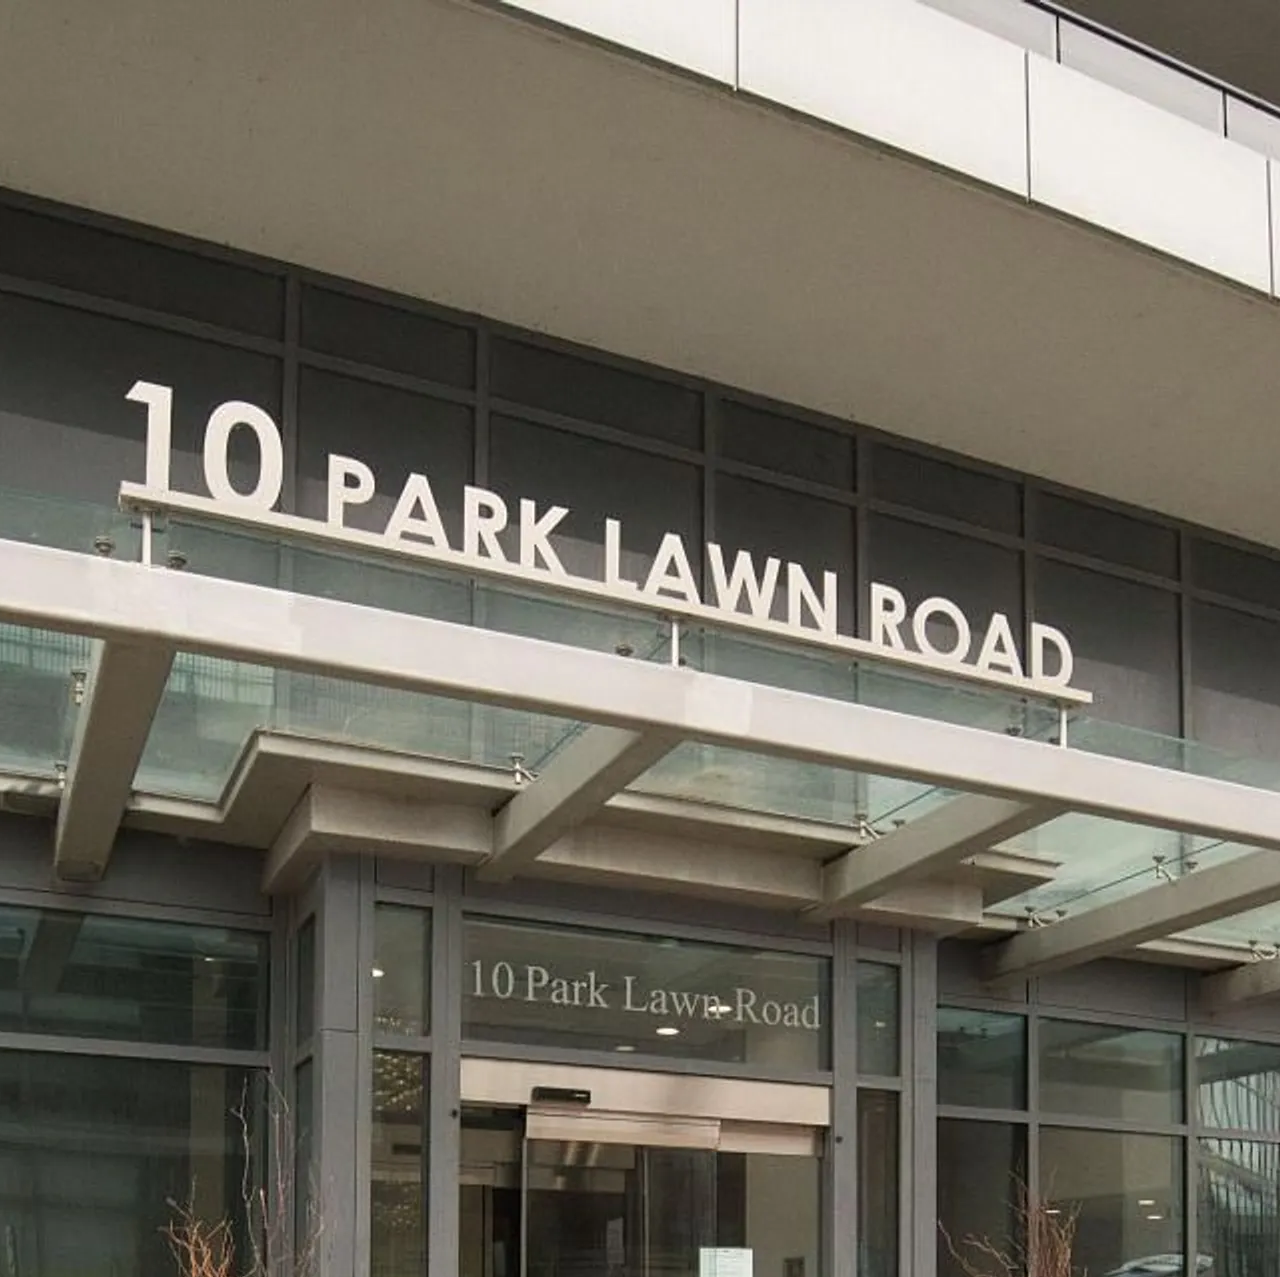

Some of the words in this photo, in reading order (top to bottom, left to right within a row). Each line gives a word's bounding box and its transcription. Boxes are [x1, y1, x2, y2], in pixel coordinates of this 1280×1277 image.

[123, 380, 284, 513] 10
[327, 453, 572, 580] PARK
[604, 517, 838, 641] LAWN
[870, 581, 1075, 690] ROAD
[471, 959, 516, 999] 10
[524, 965, 611, 1009] Park
[623, 975, 722, 1021] Lawn
[734, 987, 822, 1030] Road
